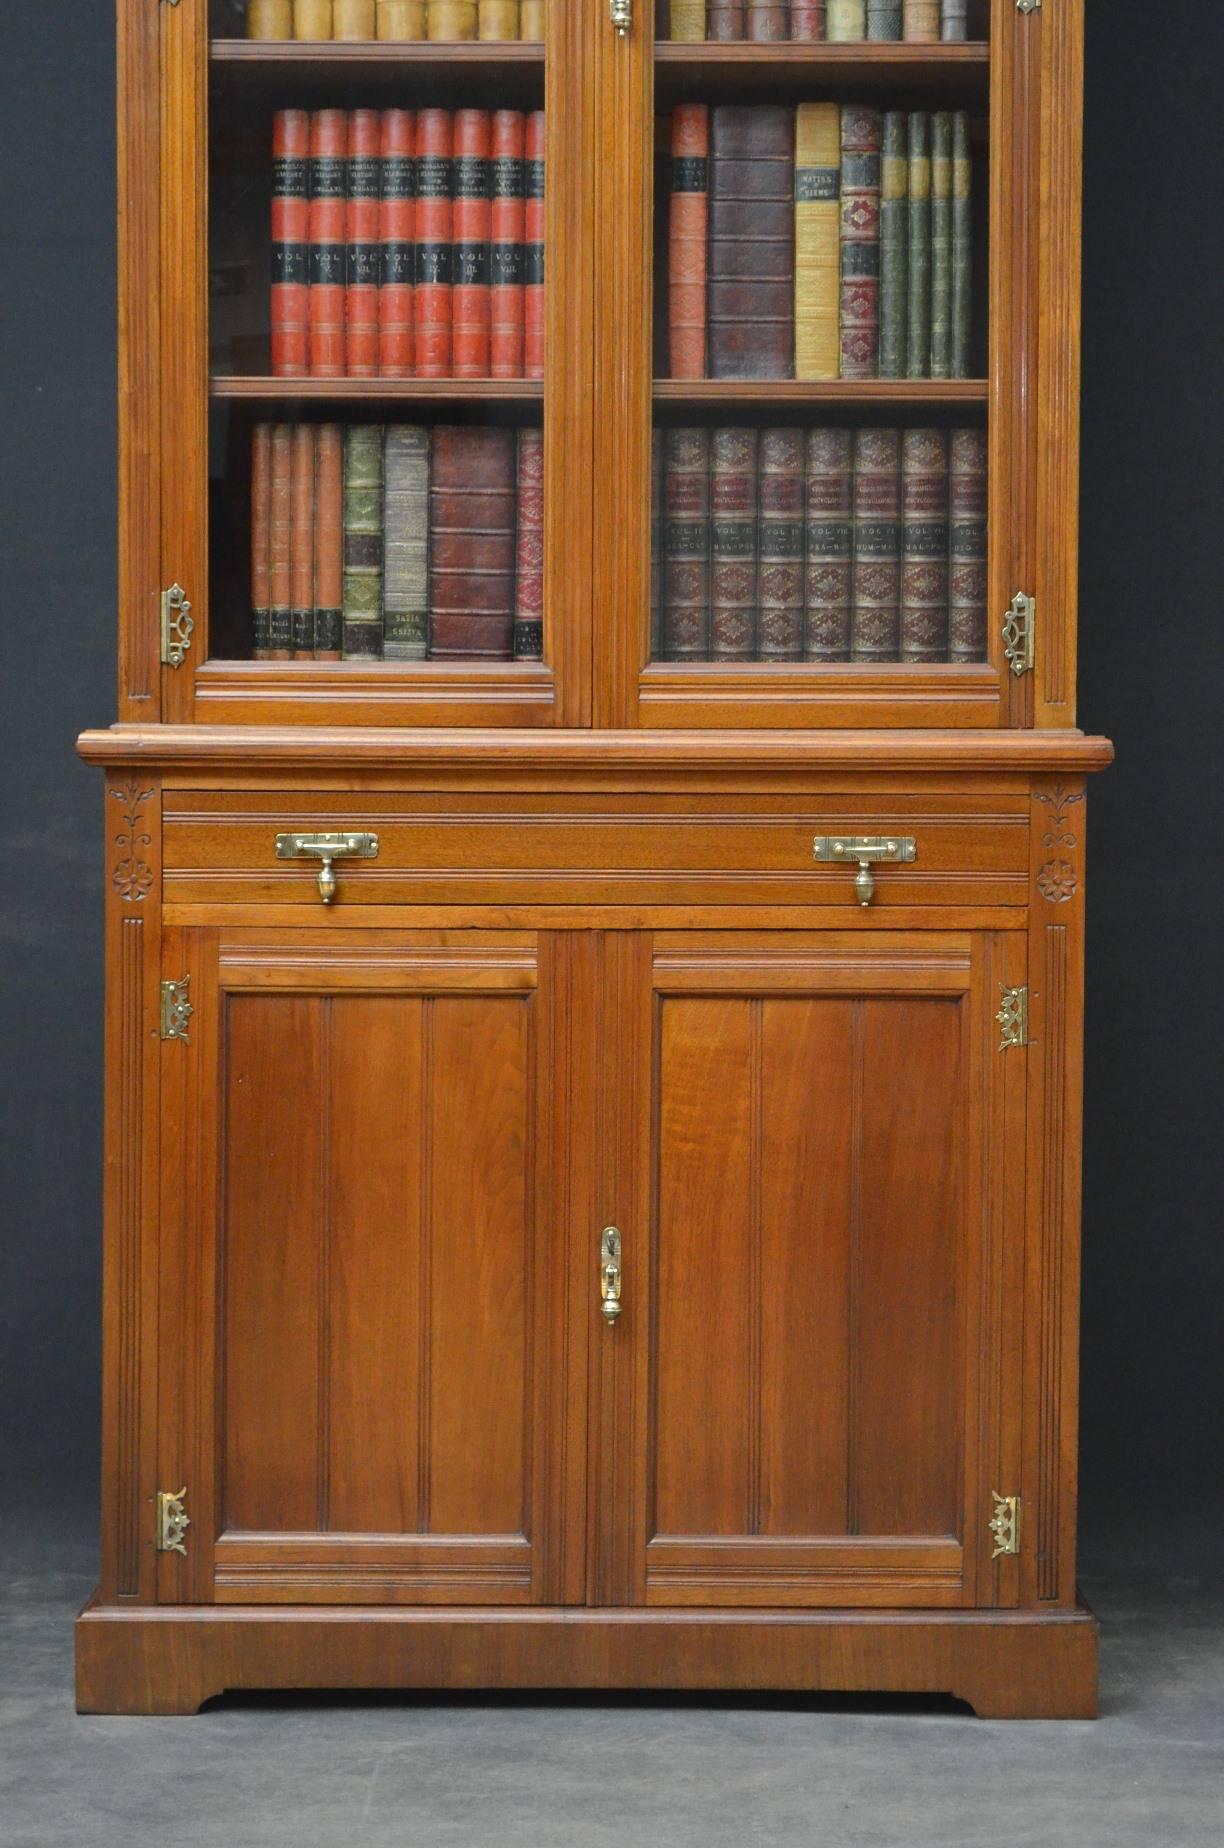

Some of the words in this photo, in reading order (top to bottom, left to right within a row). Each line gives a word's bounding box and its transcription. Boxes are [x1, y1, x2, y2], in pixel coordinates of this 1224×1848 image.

[277, 252, 303, 261] VOL
[315, 252, 341, 261] VOL
[351, 252, 376, 261] VOL
[385, 252, 409, 261] VOL
[421, 252, 447, 261] VOL
[460, 252, 485, 261] VOL
[496, 252, 521, 261] VOL
[716, 527, 736, 535] VOL
